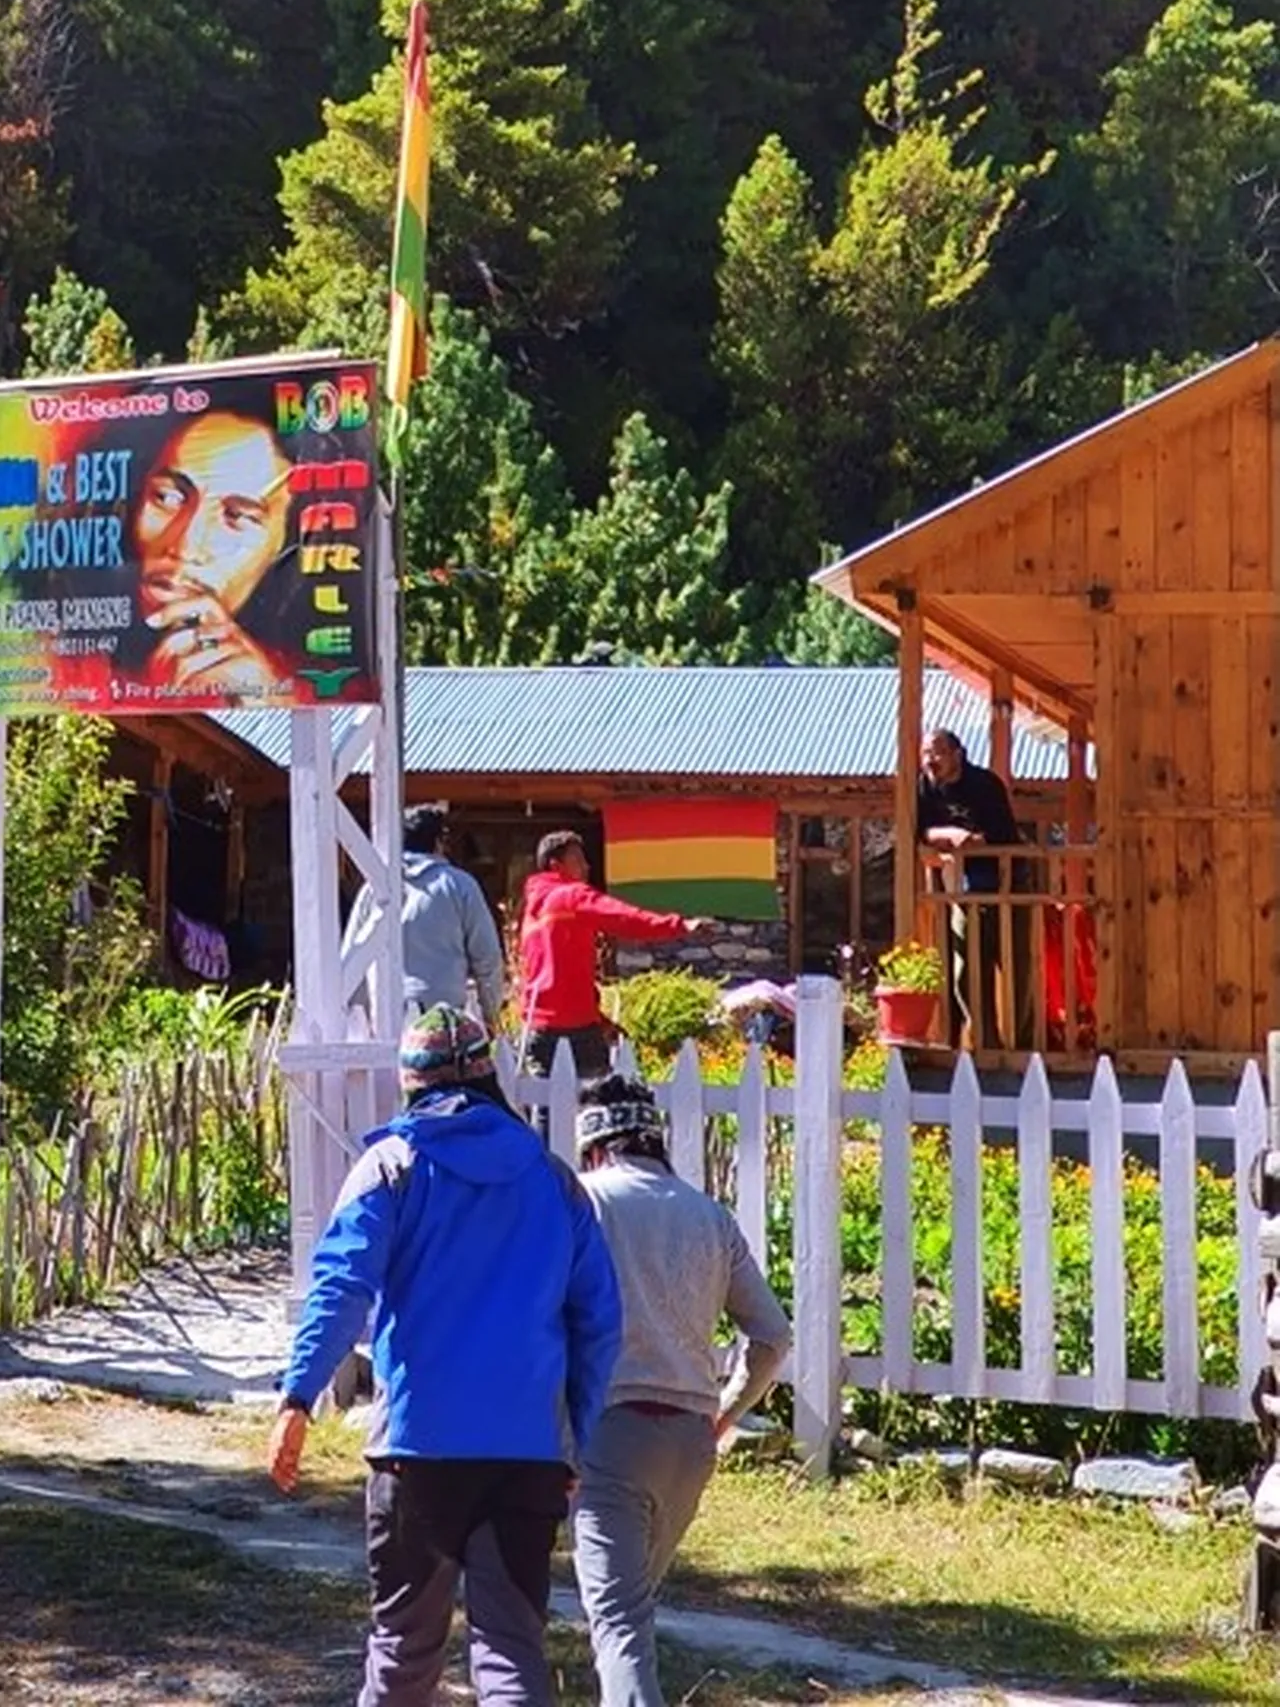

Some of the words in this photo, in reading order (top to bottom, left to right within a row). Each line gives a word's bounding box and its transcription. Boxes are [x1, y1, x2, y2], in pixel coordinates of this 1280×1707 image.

[30, 392, 169, 424] Welcome
[173, 387, 210, 412] to
[275, 375, 370, 435] BOB
[46, 463, 68, 504] &
[74, 449, 133, 502] BEST
[18, 515, 124, 570] SHOWER
